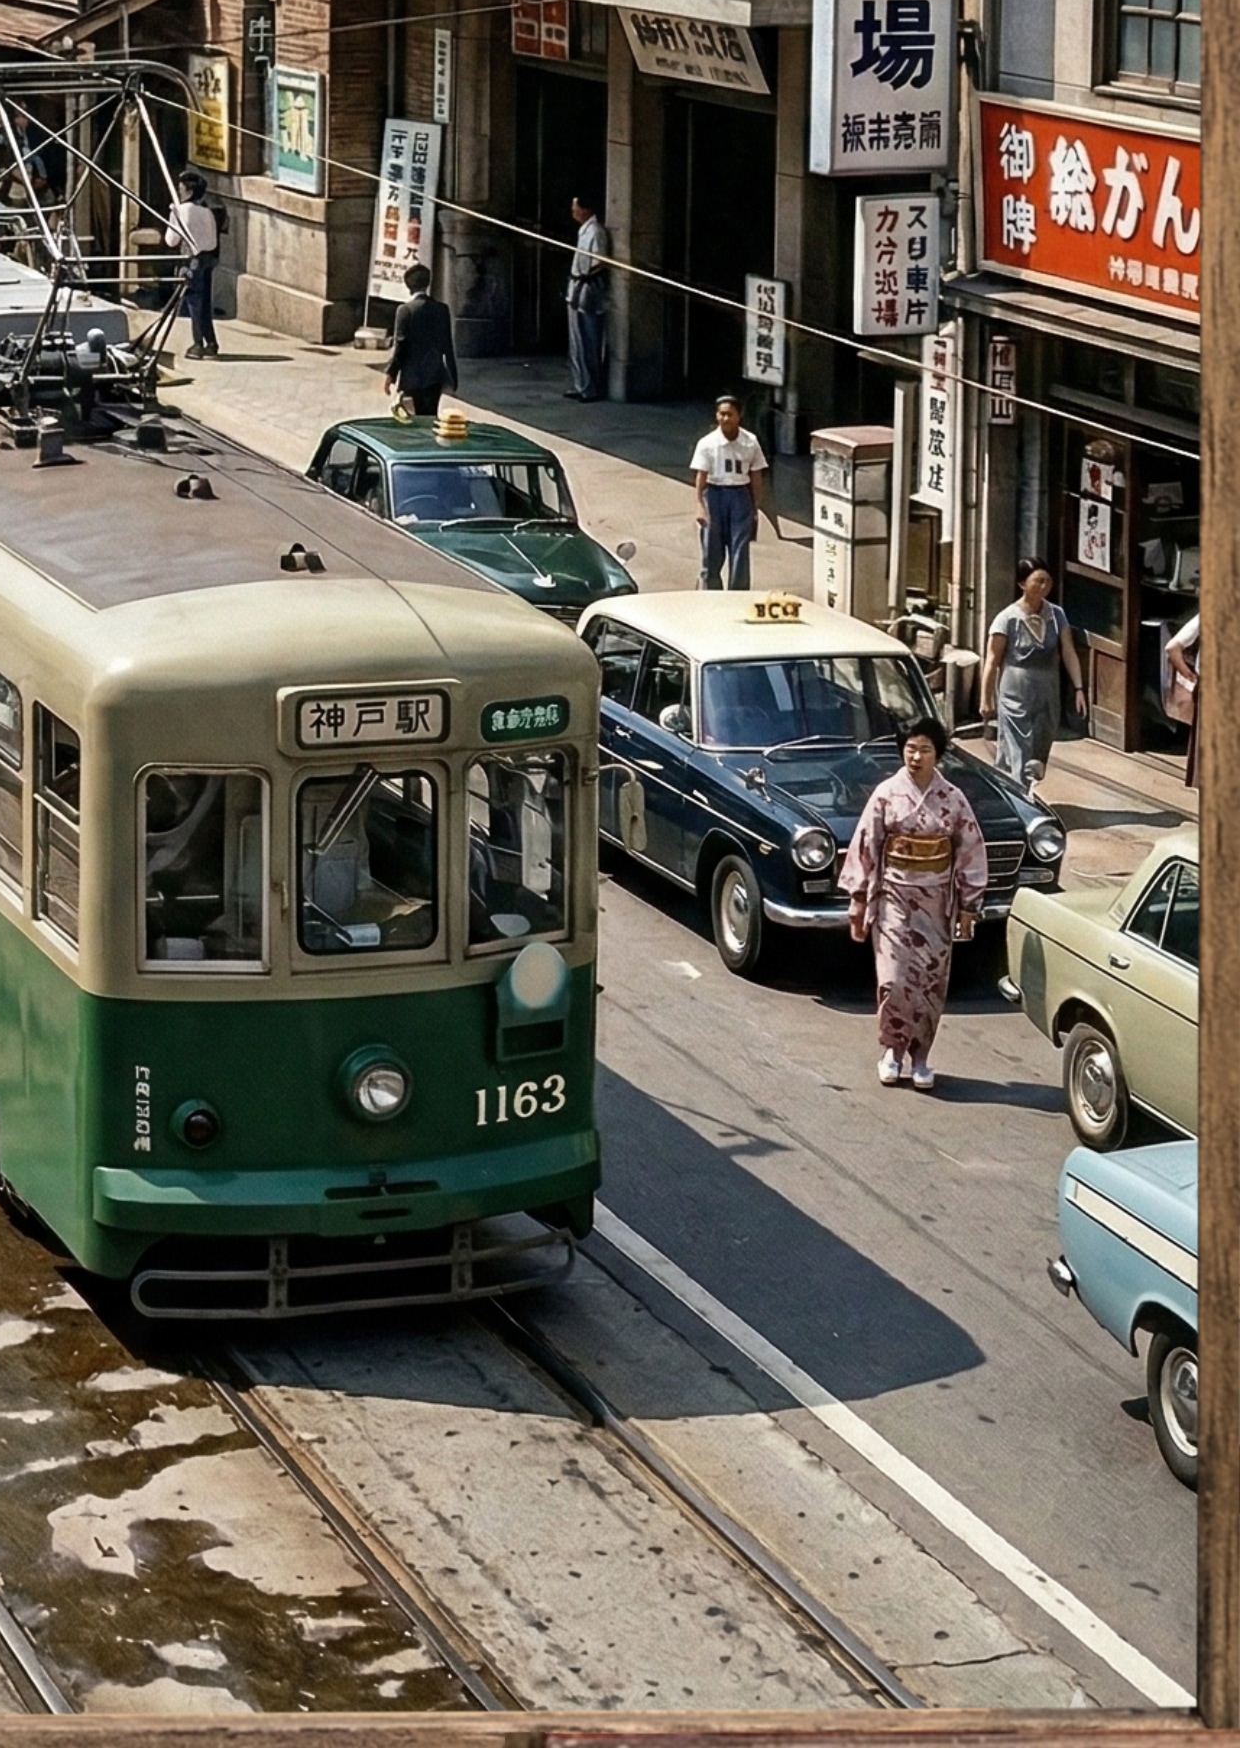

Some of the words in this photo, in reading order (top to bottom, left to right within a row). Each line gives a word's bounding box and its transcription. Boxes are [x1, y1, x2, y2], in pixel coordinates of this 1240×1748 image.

[309, 698, 431, 739] 神戸駅
[476, 1074, 567, 1126] 1163
